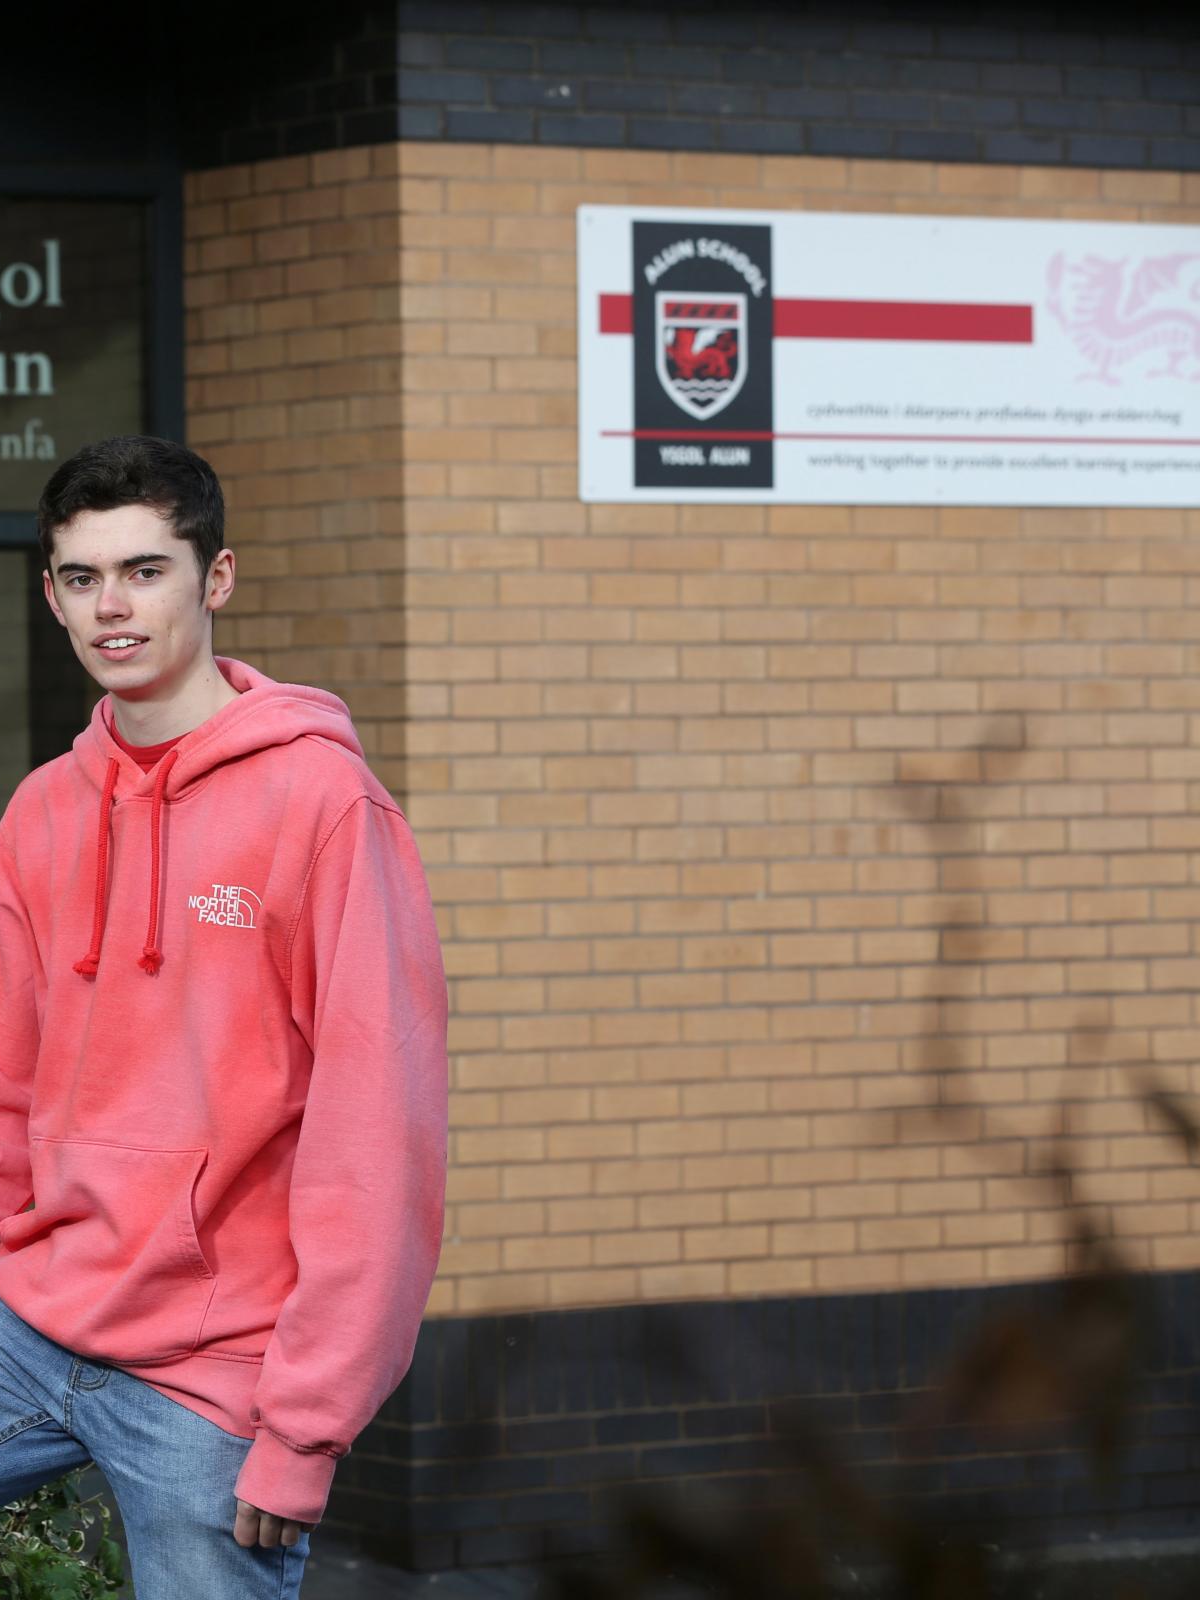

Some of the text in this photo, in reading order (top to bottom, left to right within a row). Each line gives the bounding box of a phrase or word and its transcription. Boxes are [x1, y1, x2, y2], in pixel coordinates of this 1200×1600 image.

[644, 238, 768, 298] ALUN SCHOOL
[659, 445, 752, 466] YSGOL ALUN
[211, 884, 238, 900] THE
[188, 896, 237, 913] NORTH
[197, 909, 236, 927] FACE
